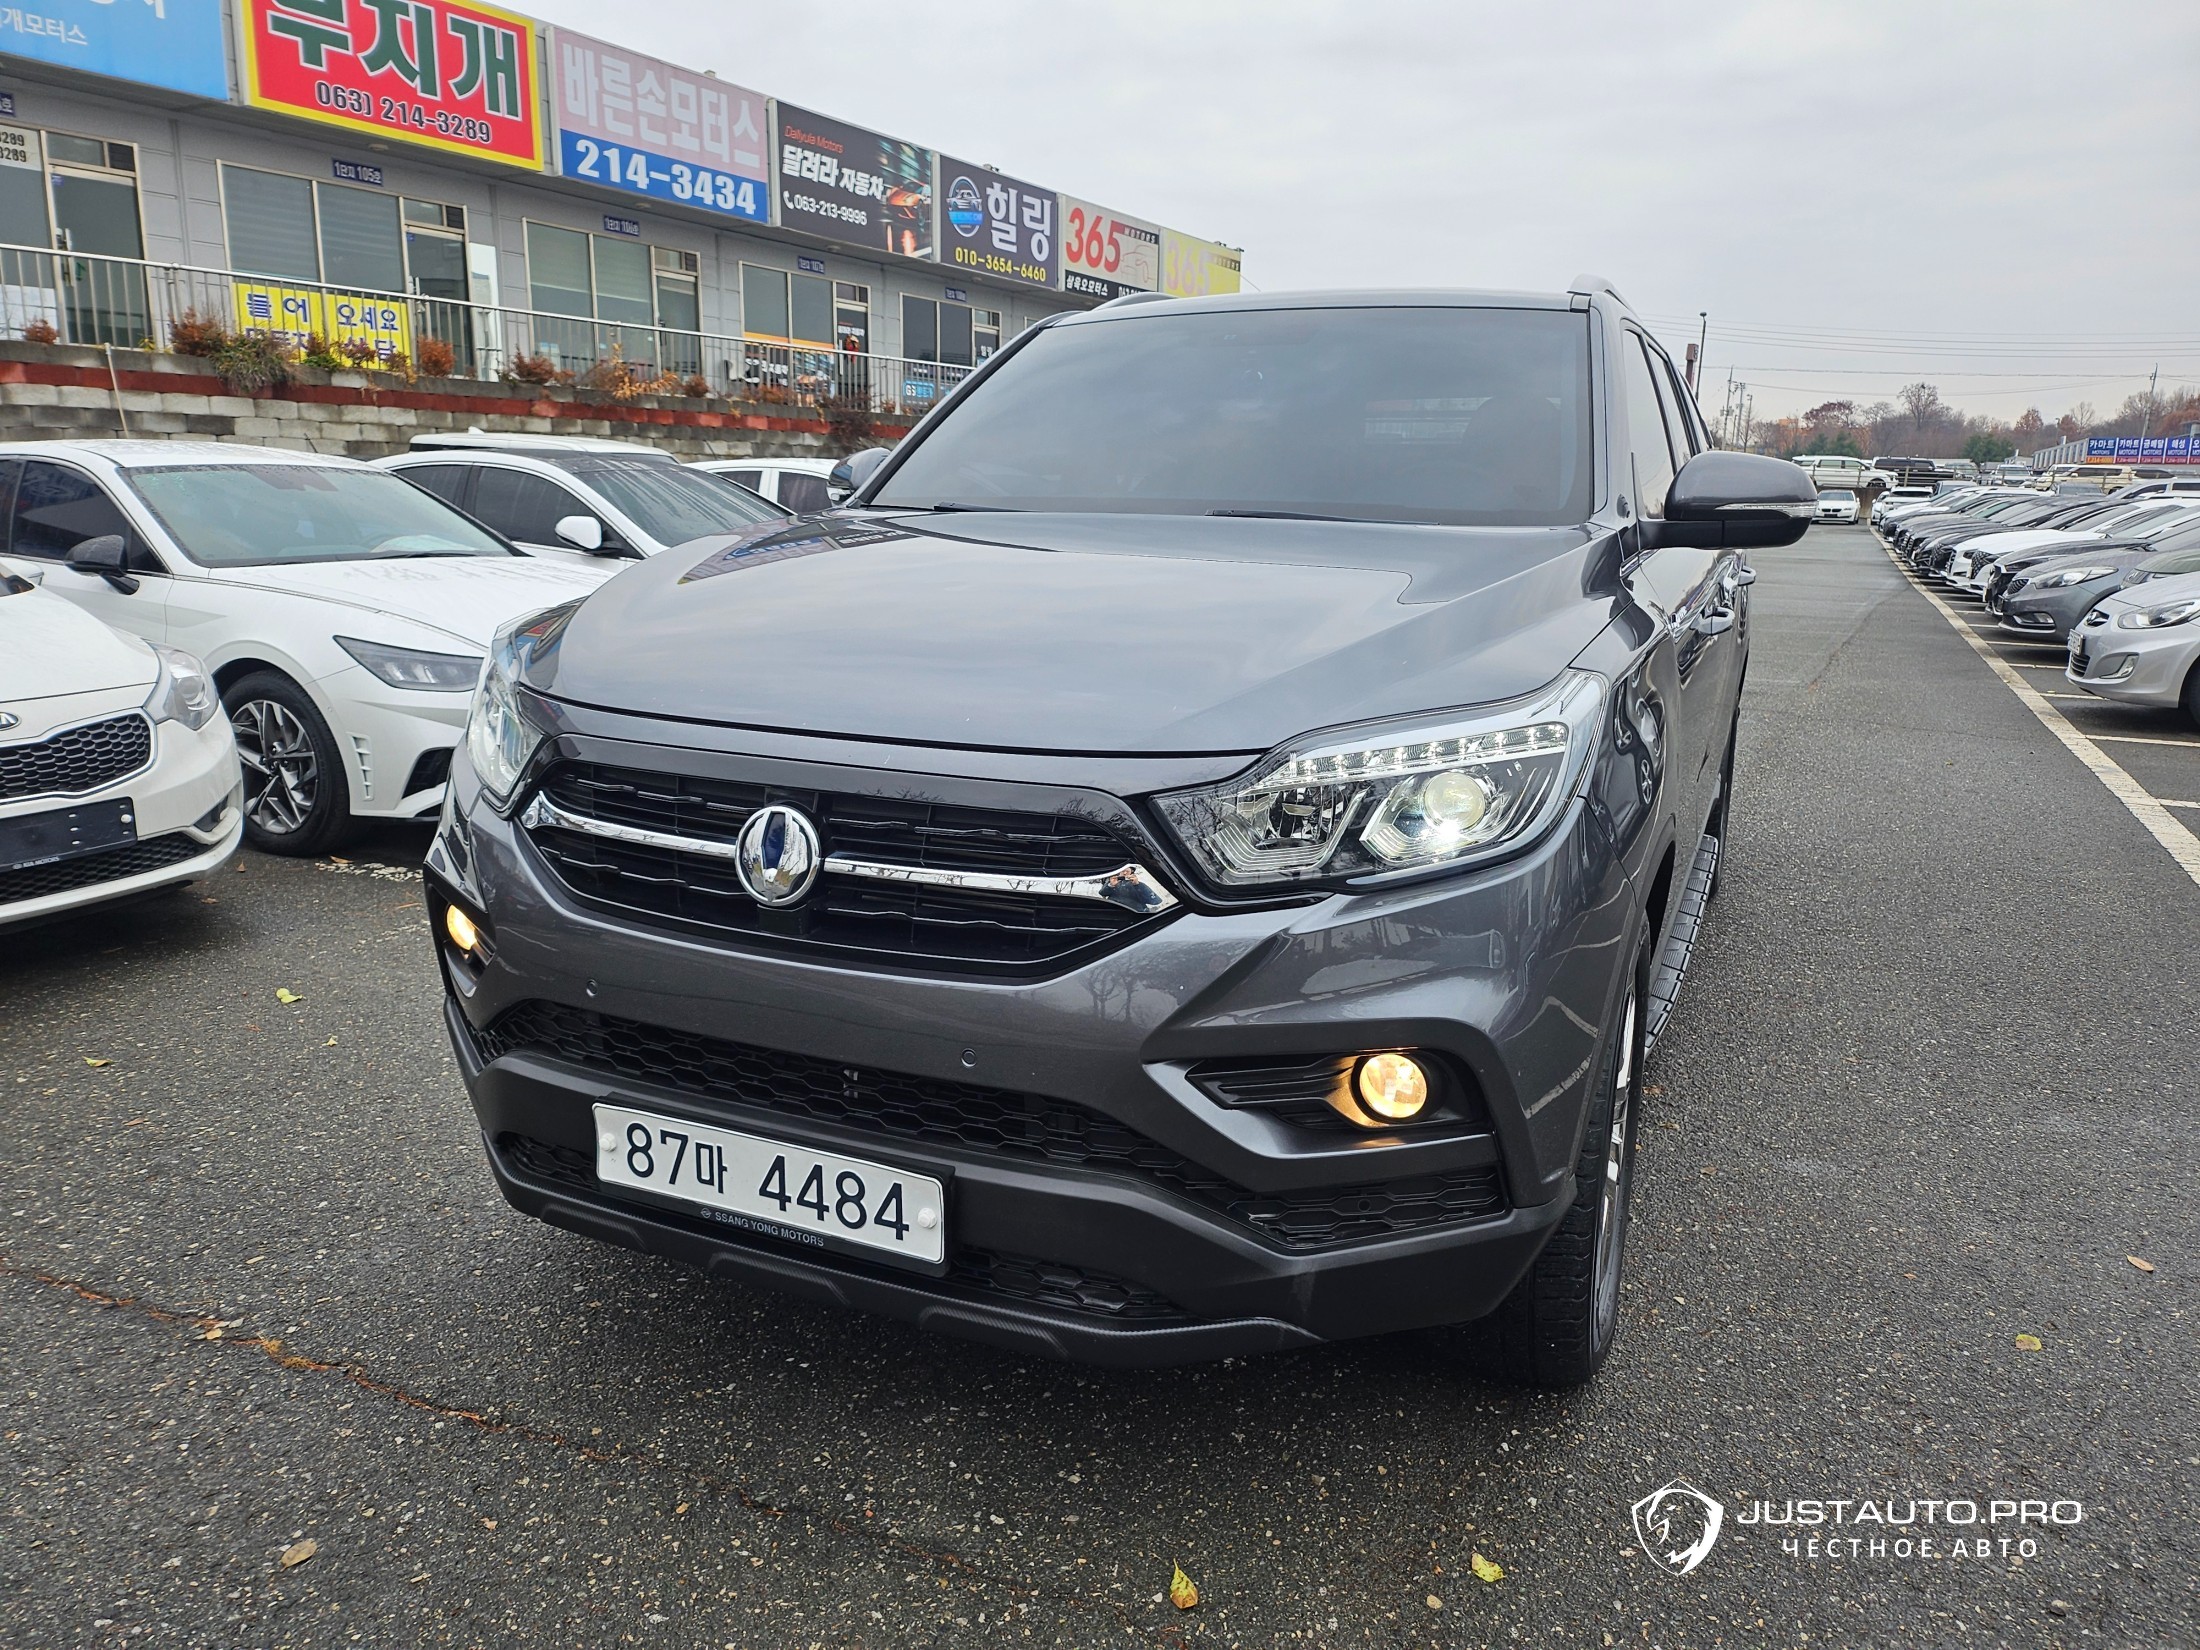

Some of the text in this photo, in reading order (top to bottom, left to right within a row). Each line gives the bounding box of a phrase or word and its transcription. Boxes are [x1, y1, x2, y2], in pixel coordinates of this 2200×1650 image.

[0, 8, 88, 45] 개모터스
[315, 81, 492, 143] 063) 214-3289
[562, 43, 760, 168] 바른손모터스
[817, 136, 844, 154] Motors
[576, 139, 756, 215] 214-3434
[782, 144, 885, 200] 달려라 자동차
[794, 194, 868, 226] 063-213-9996
[985, 181, 1052, 262] 힐링
[1066, 207, 1121, 273] 365
[1124, 226, 1156, 244] MOTORS
[955, 246, 1046, 282] 010-3654-6460
[1066, 275, 1108, 296] 삼육오모터스
[337, 303, 398, 331] 오세요
[2090, 440, 2115, 449] 카마트
[626, 1122, 910, 1241] 87마 4484
[715, 1211, 824, 1247] SSANG YONG MOTORS
